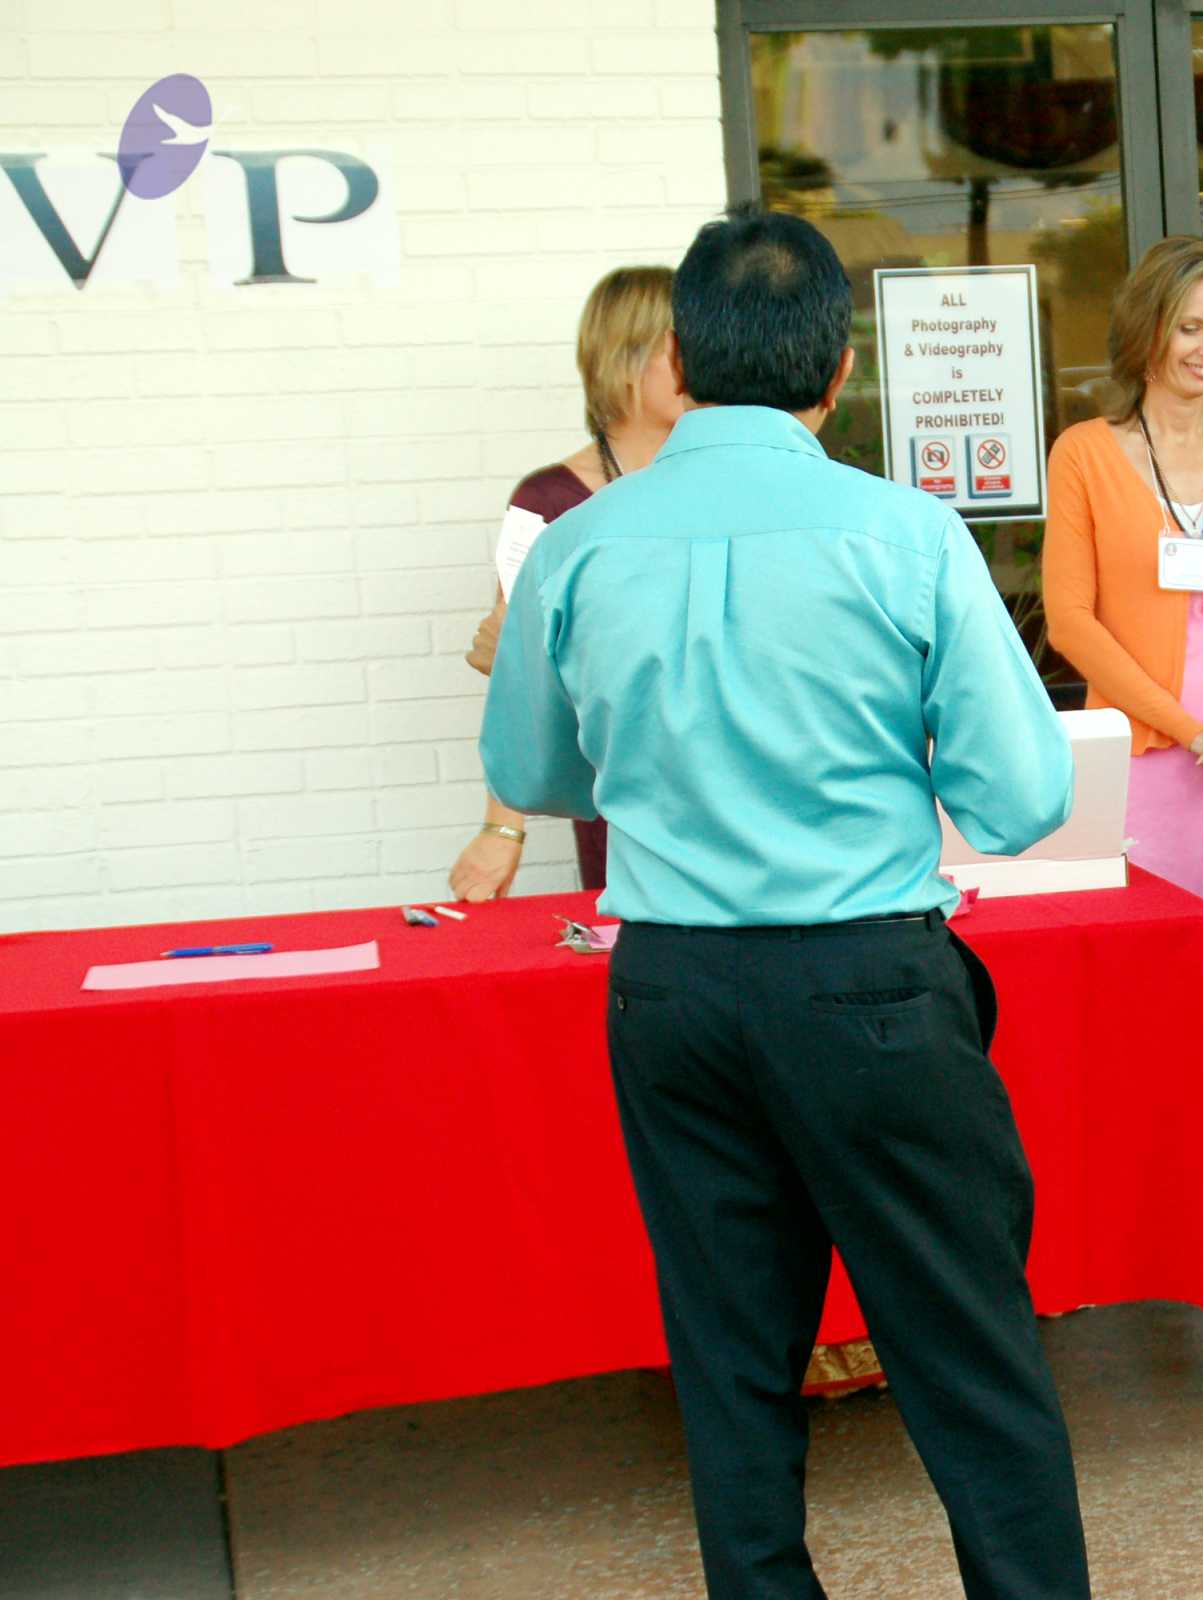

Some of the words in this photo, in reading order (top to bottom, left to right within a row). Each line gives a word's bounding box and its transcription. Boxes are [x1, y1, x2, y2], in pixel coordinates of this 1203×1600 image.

[941, 293, 967, 307] ALL
[911, 317, 997, 334] Photography
[904, 344, 914, 357] &
[919, 341, 1004, 358] Videography
[951, 366, 963, 379] is
[912, 388, 1004, 405] COMPLETELY
[915, 412, 1004, 429] PROHIBITED!
